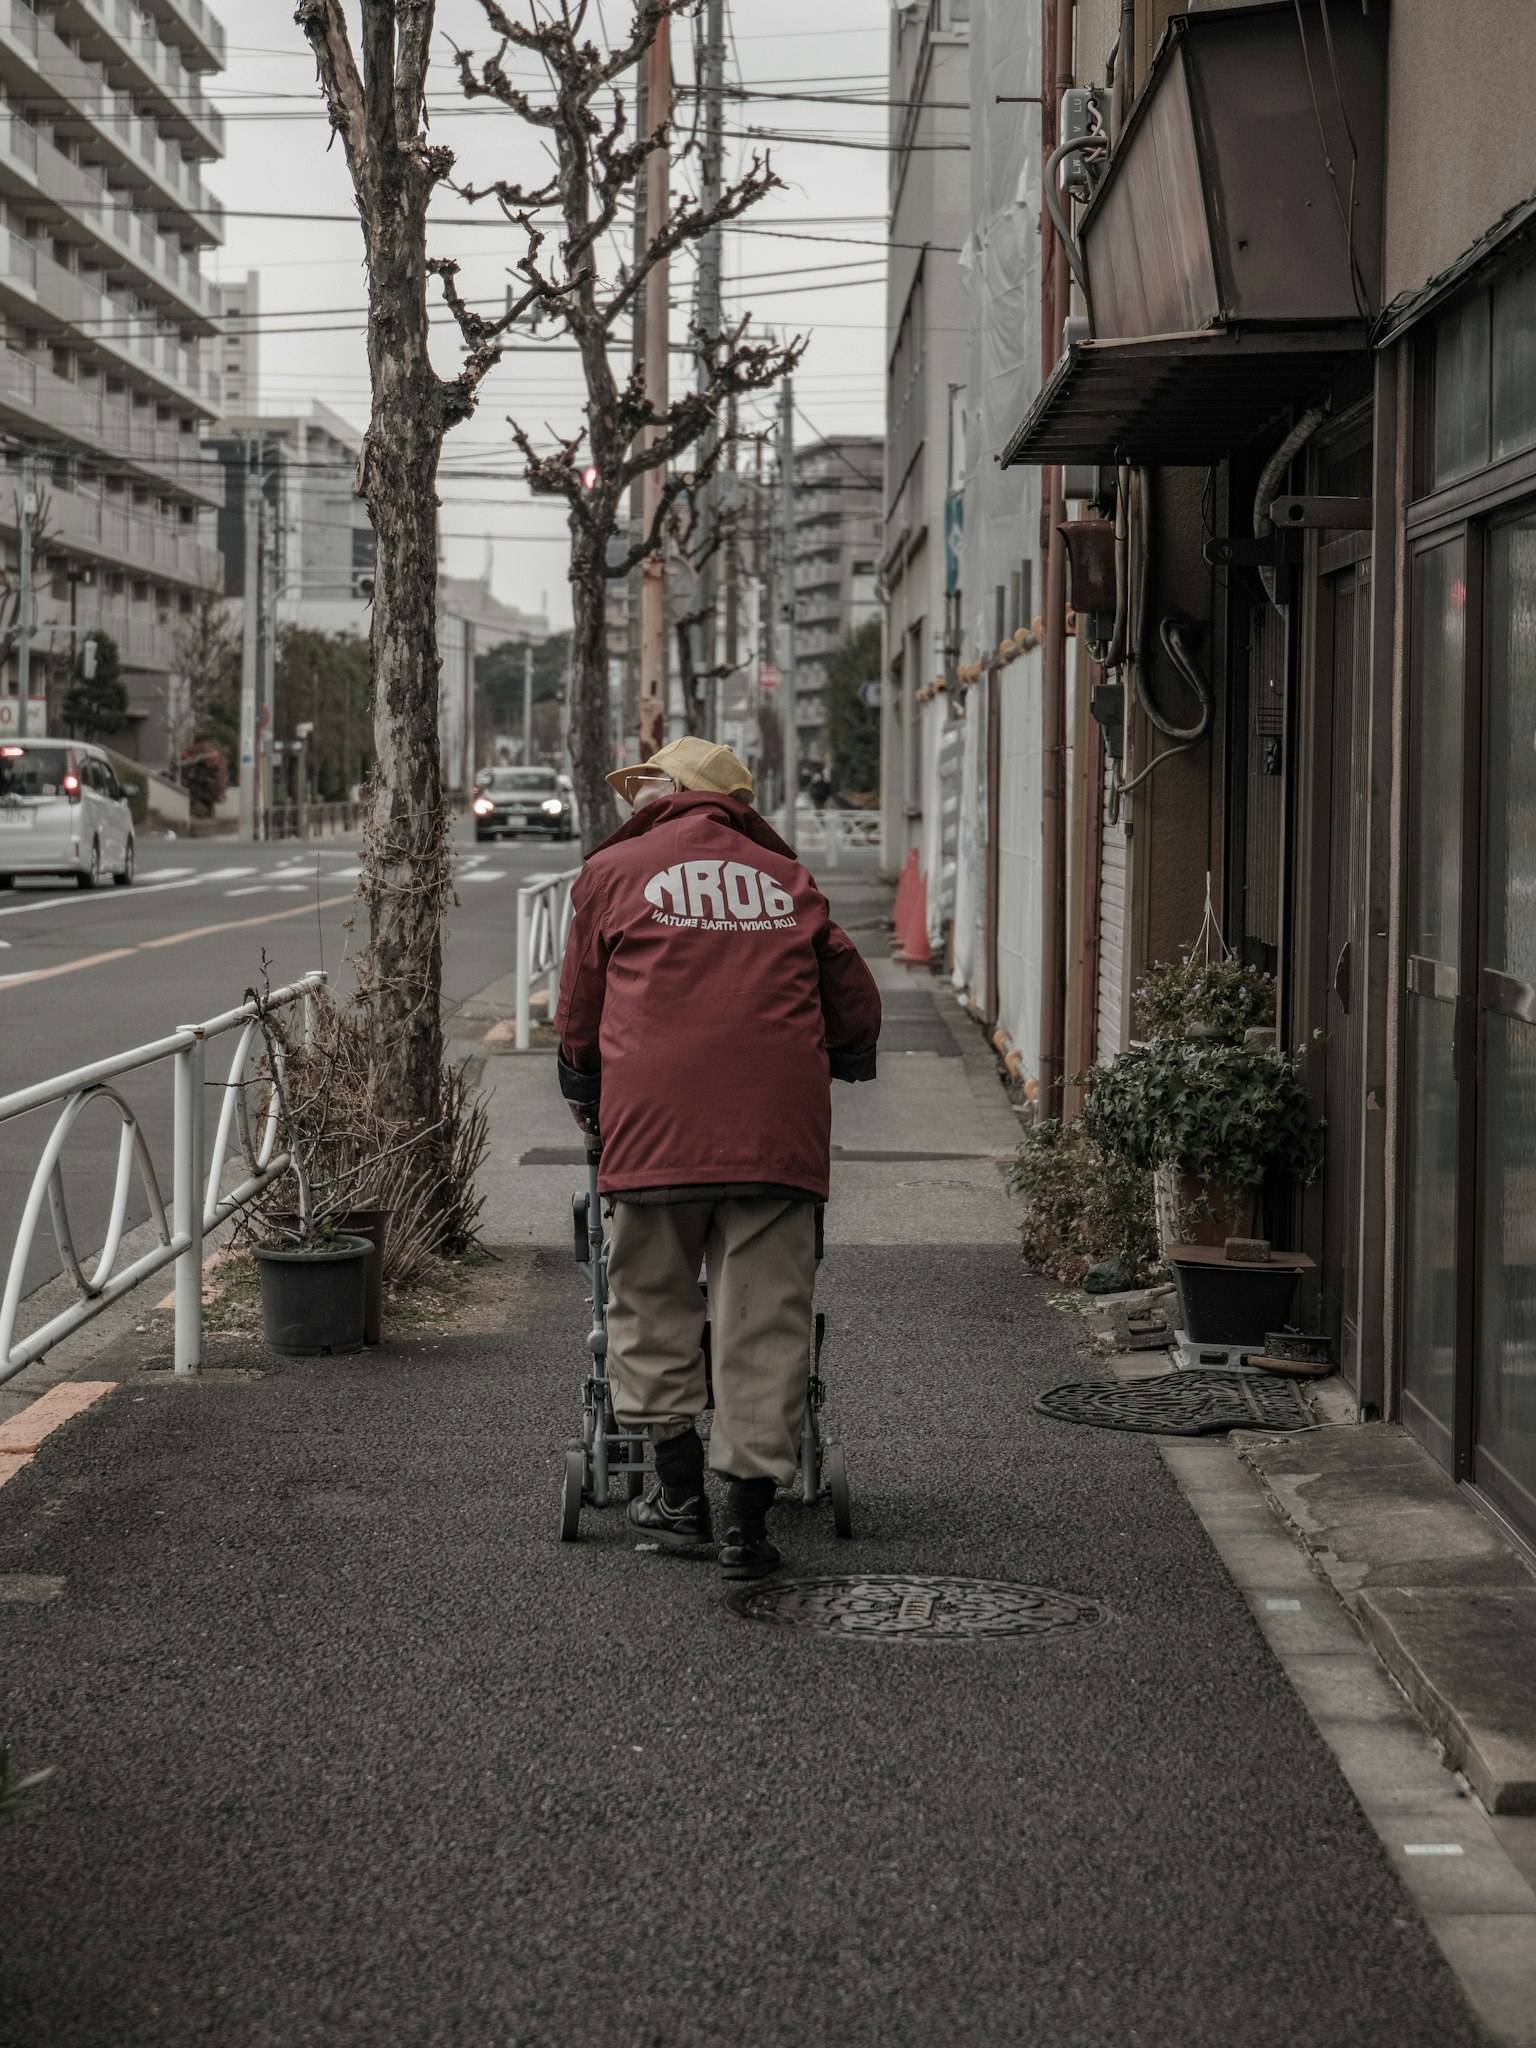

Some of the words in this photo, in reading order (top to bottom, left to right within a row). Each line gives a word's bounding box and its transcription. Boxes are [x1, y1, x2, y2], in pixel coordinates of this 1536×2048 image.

[1073, 98, 1082, 113] LU
[1073, 125, 1082, 133] V
[1072, 159, 1081, 174] LW
[651, 909, 698, 928] NATURE
[700, 918, 738, 931] EARTH
[739, 919, 773, 931] WIND
[773, 915, 797, 930] ROLL
